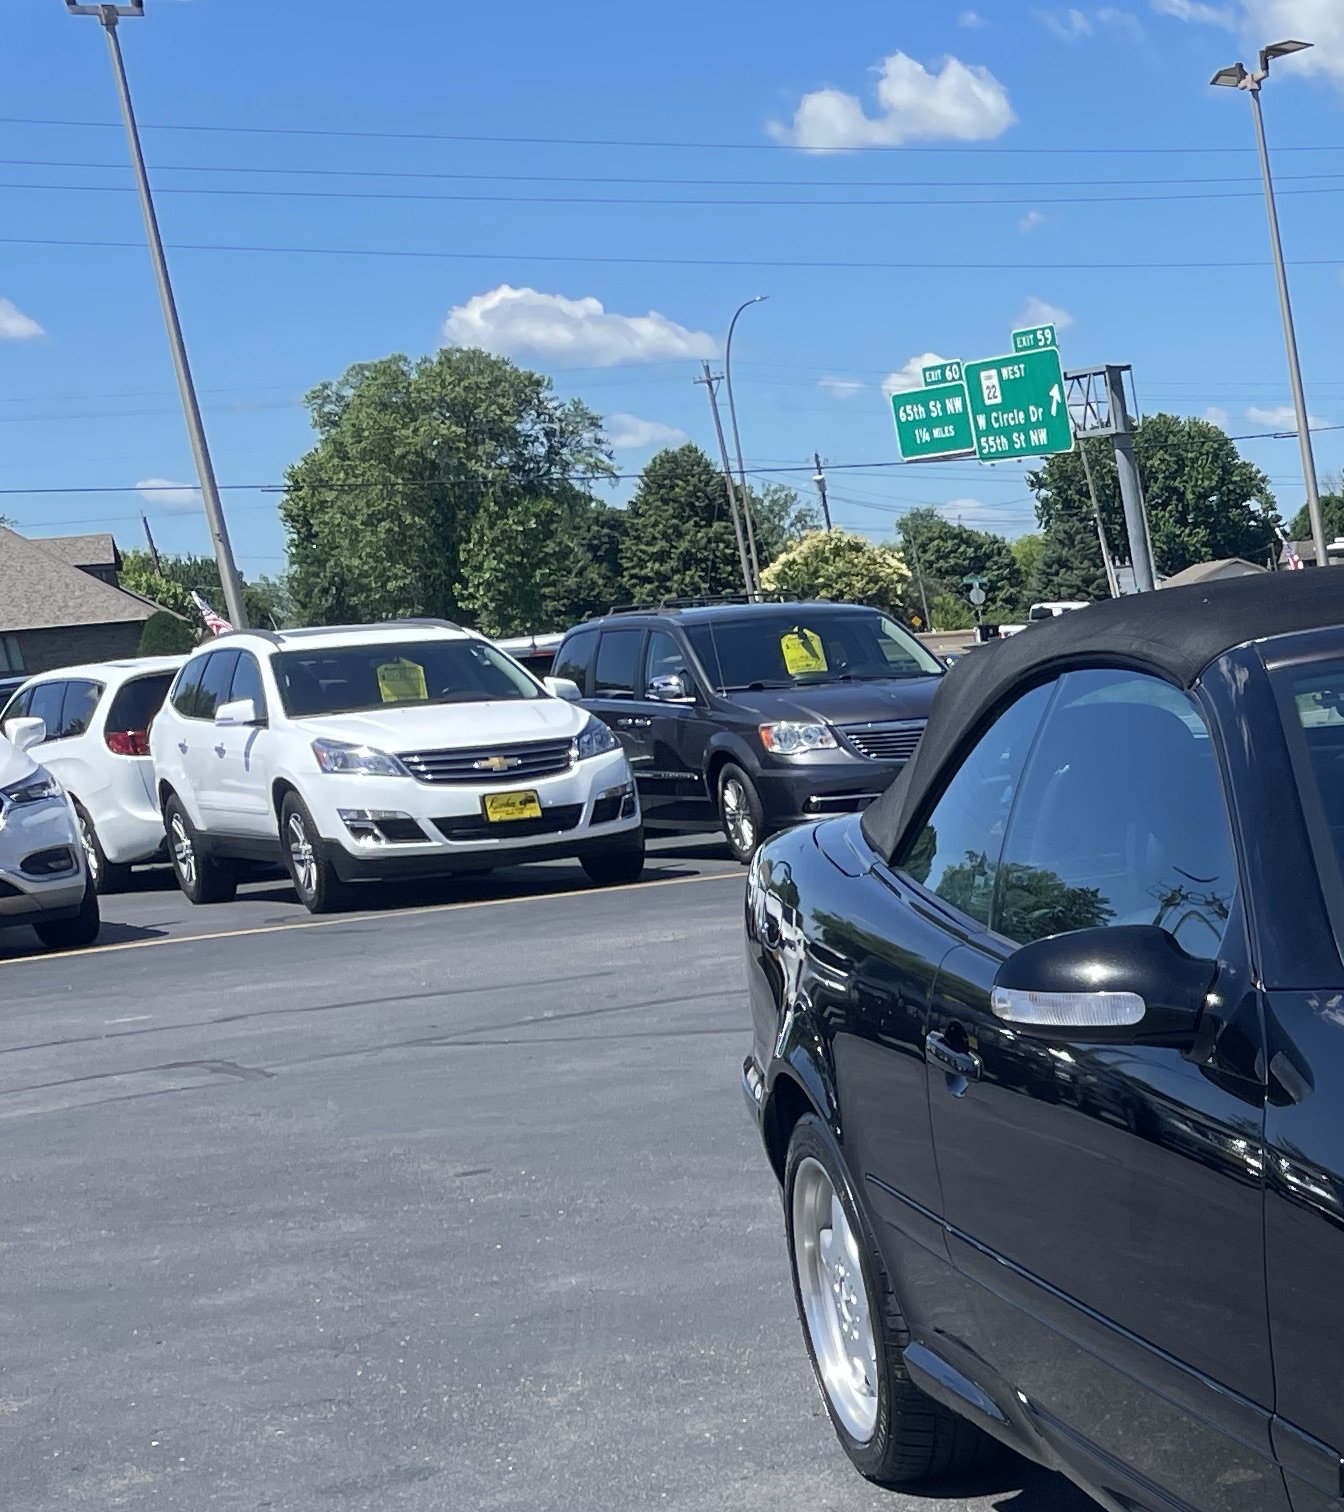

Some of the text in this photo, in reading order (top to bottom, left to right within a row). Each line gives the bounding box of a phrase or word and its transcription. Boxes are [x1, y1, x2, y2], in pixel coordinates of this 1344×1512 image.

[1016, 329, 1051, 348] EXIT 59
[925, 365, 960, 382] EXIT 60
[1001, 364, 1025, 380] WEST
[985, 385, 998, 400] 22
[899, 397, 963, 423] 65th St NW
[976, 405, 1043, 430] W Circle Dr
[933, 425, 955, 439] MILES
[980, 428, 1047, 454] 55th St NW
